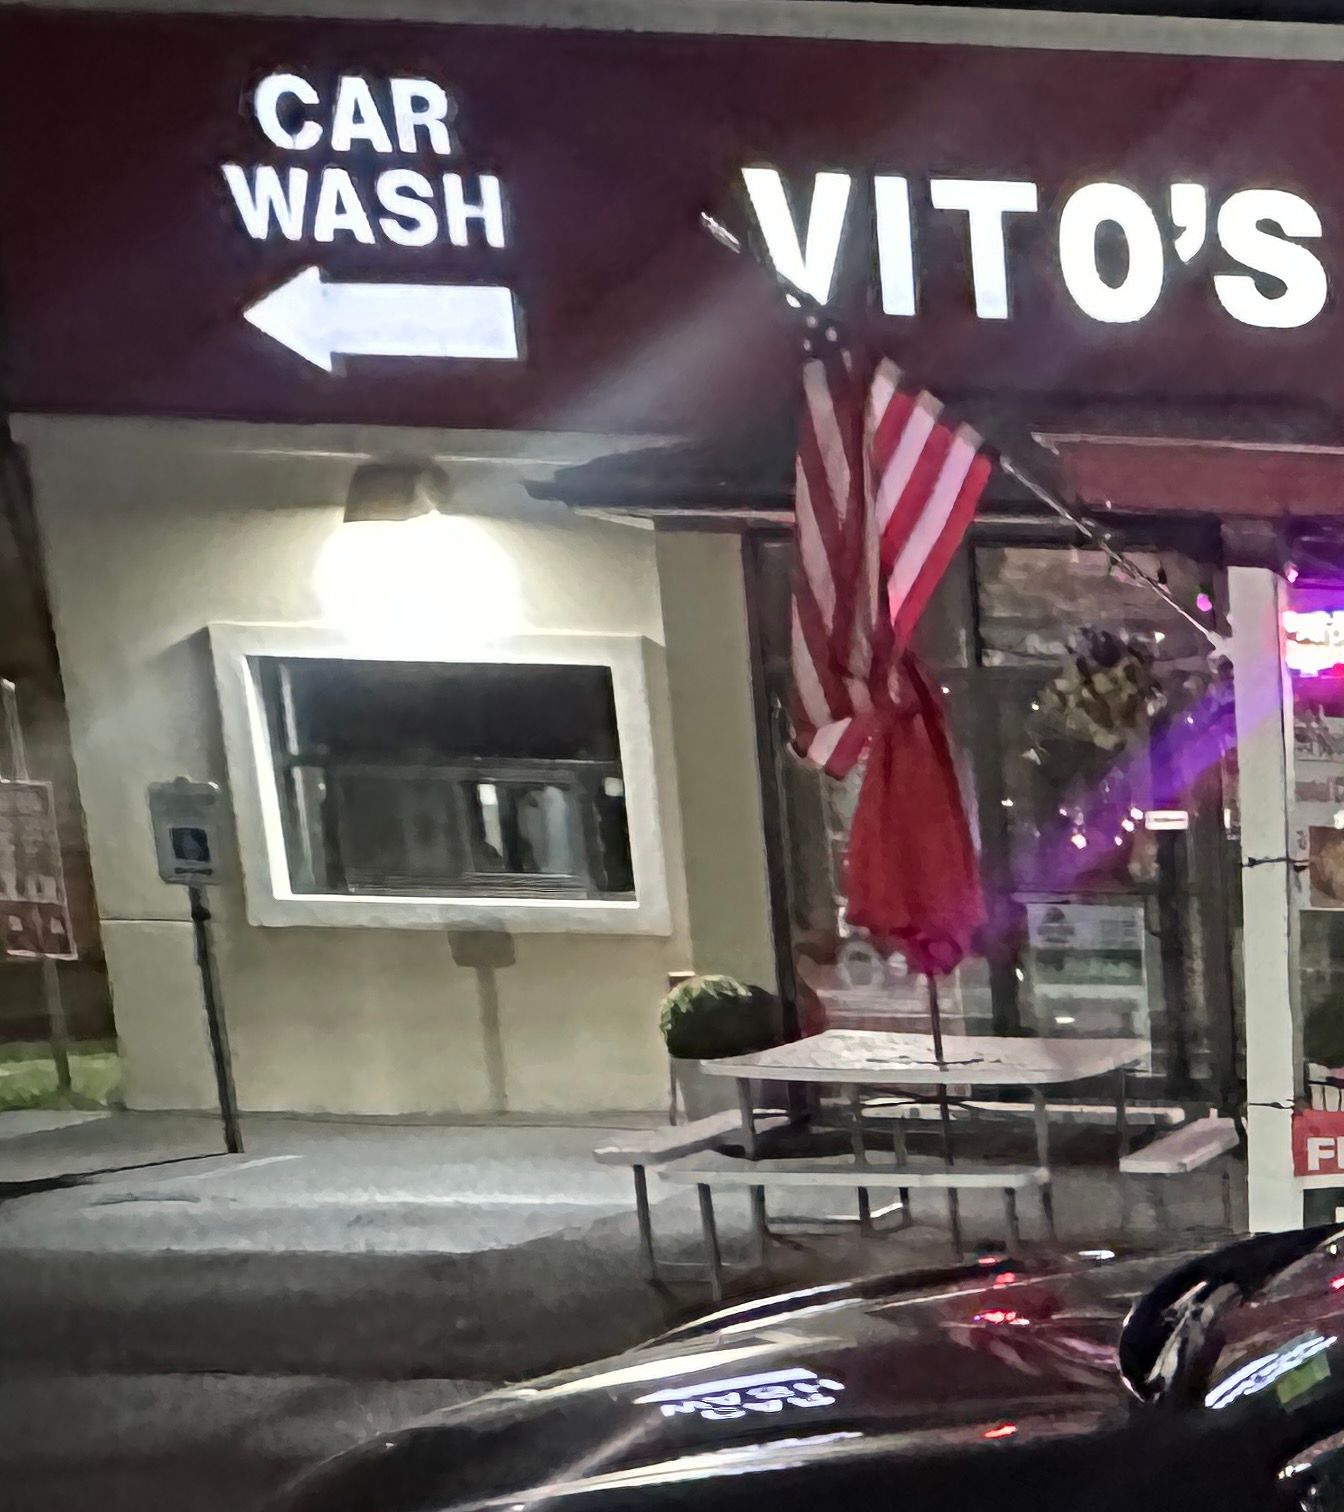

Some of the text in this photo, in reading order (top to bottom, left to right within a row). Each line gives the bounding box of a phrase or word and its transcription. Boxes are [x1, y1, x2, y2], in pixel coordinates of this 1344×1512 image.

[254, 73, 452, 156] CAR
[221, 163, 505, 249] WASH
[741, 166, 1329, 329] VITO'S
